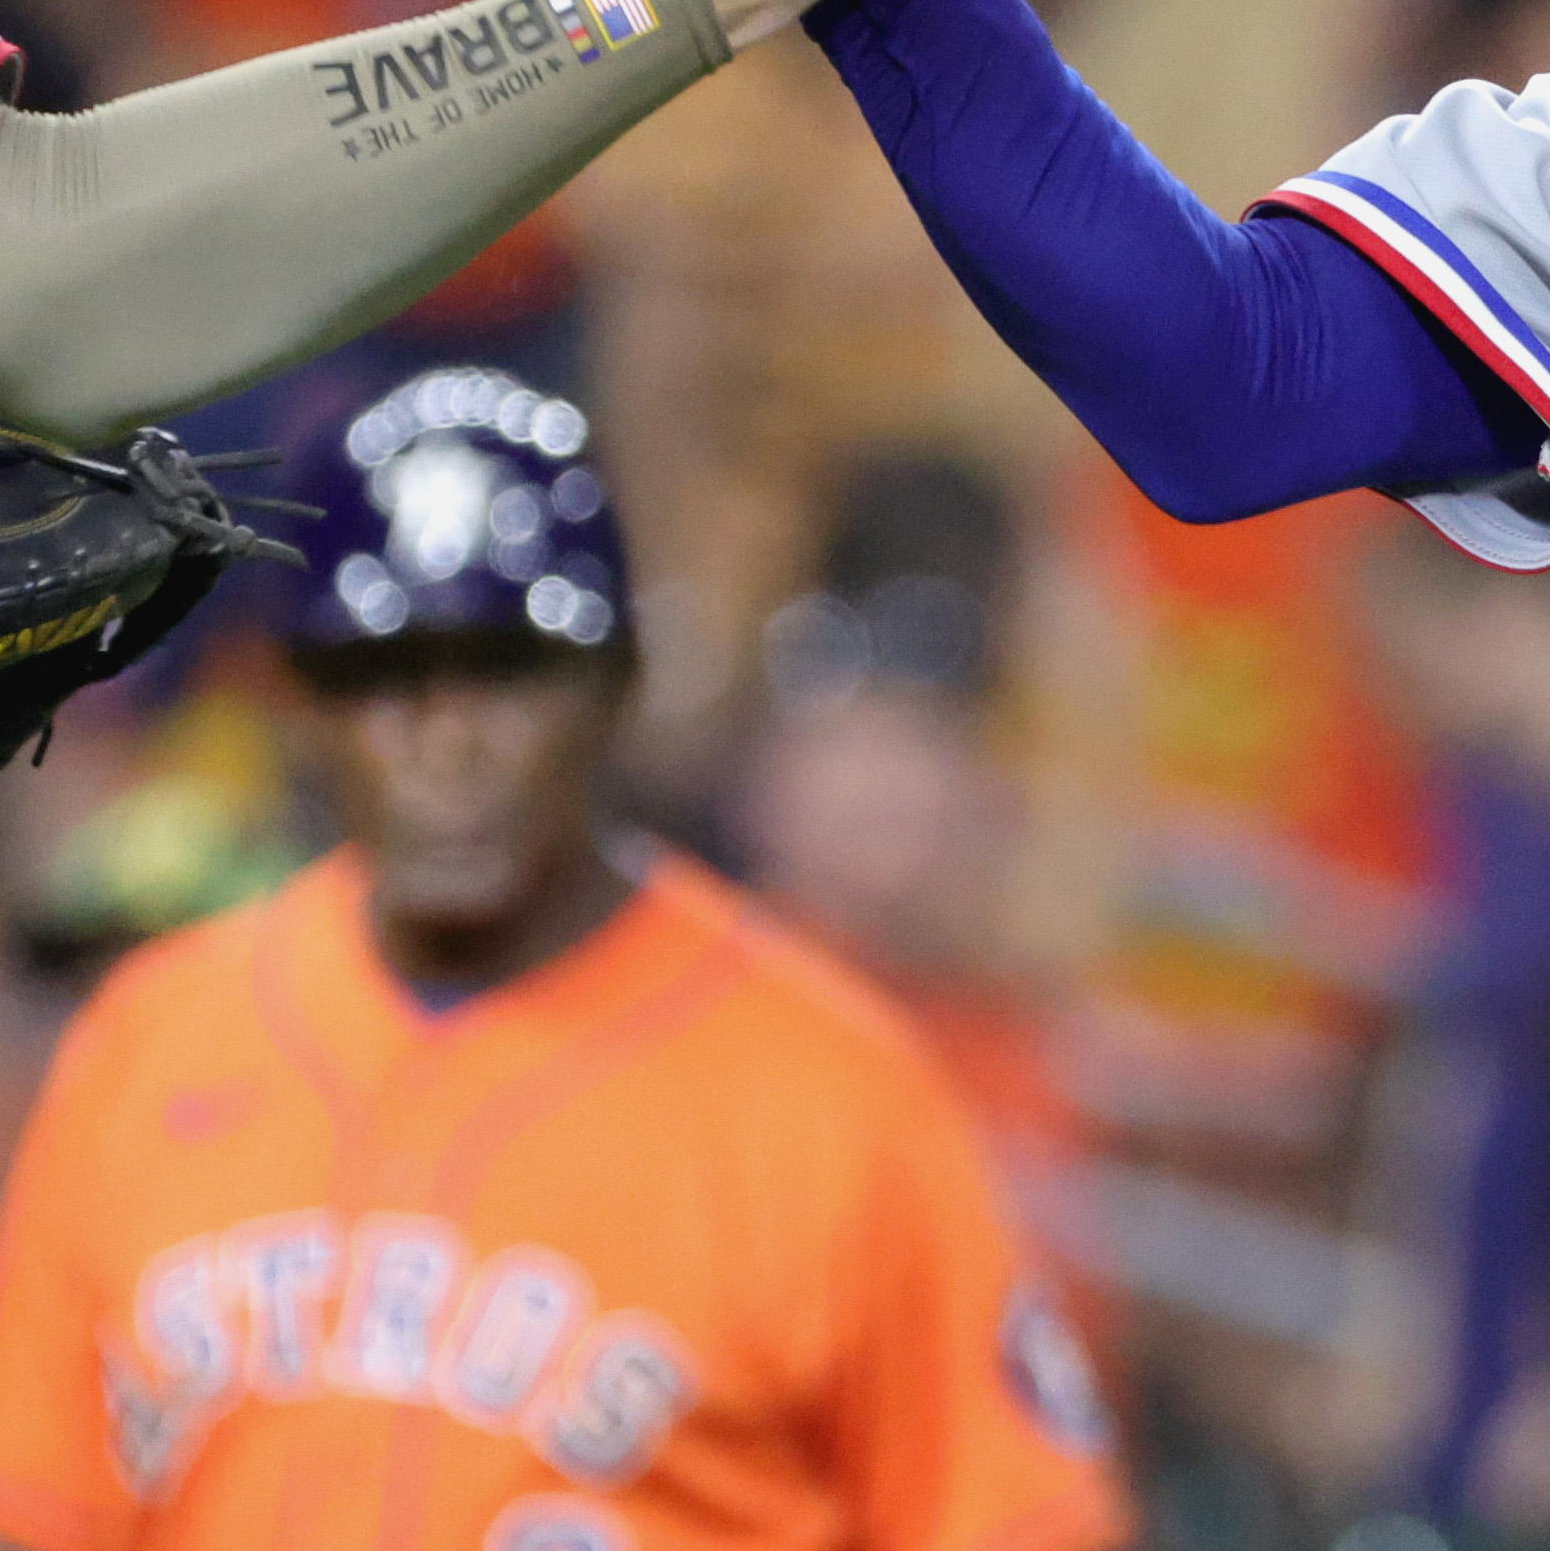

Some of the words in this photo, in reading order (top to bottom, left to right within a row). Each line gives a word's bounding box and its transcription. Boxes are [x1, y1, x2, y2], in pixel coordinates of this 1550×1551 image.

[472, 63, 545, 113] HOME
[428, 97, 464, 131] OF
[362, 118, 420, 158] THE
